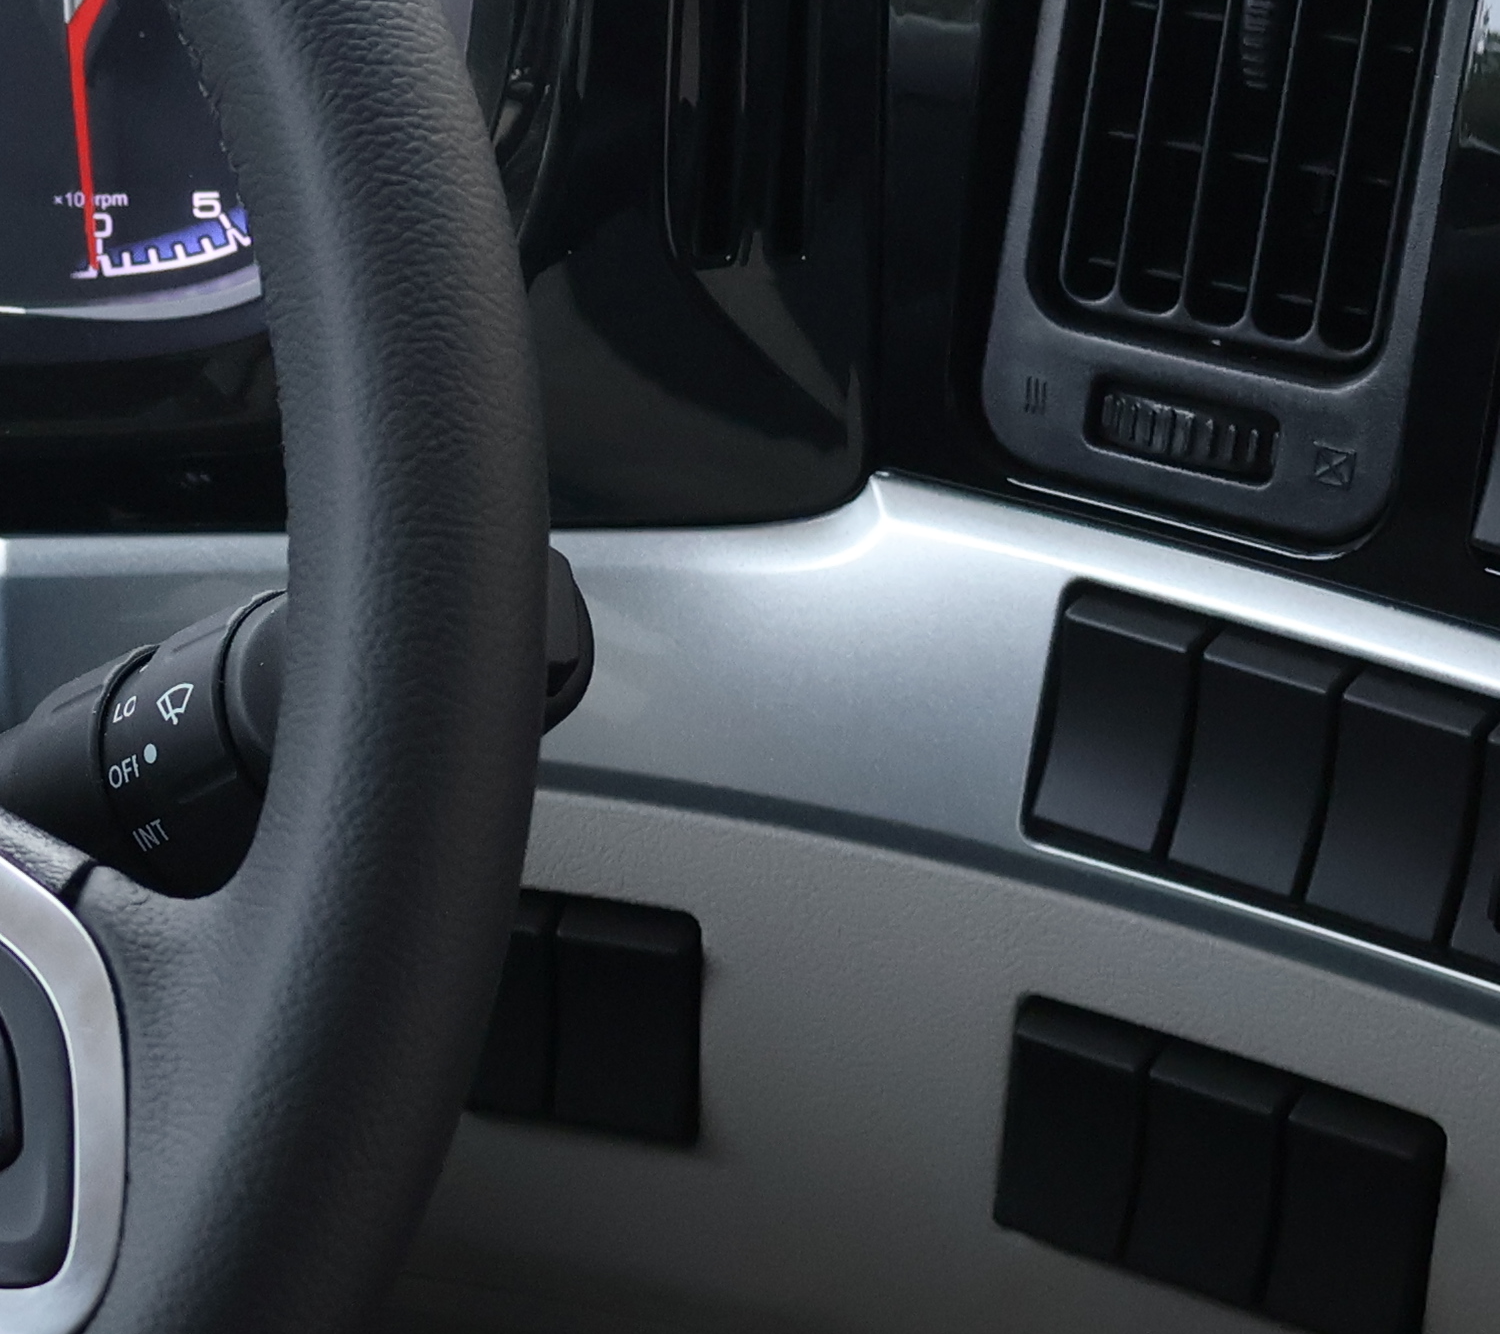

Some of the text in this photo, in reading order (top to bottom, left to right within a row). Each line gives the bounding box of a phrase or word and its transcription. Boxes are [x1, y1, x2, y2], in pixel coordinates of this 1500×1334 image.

[192, 190, 222, 219] 5
[112, 695, 138, 724] LO
[132, 818, 170, 853] INT
